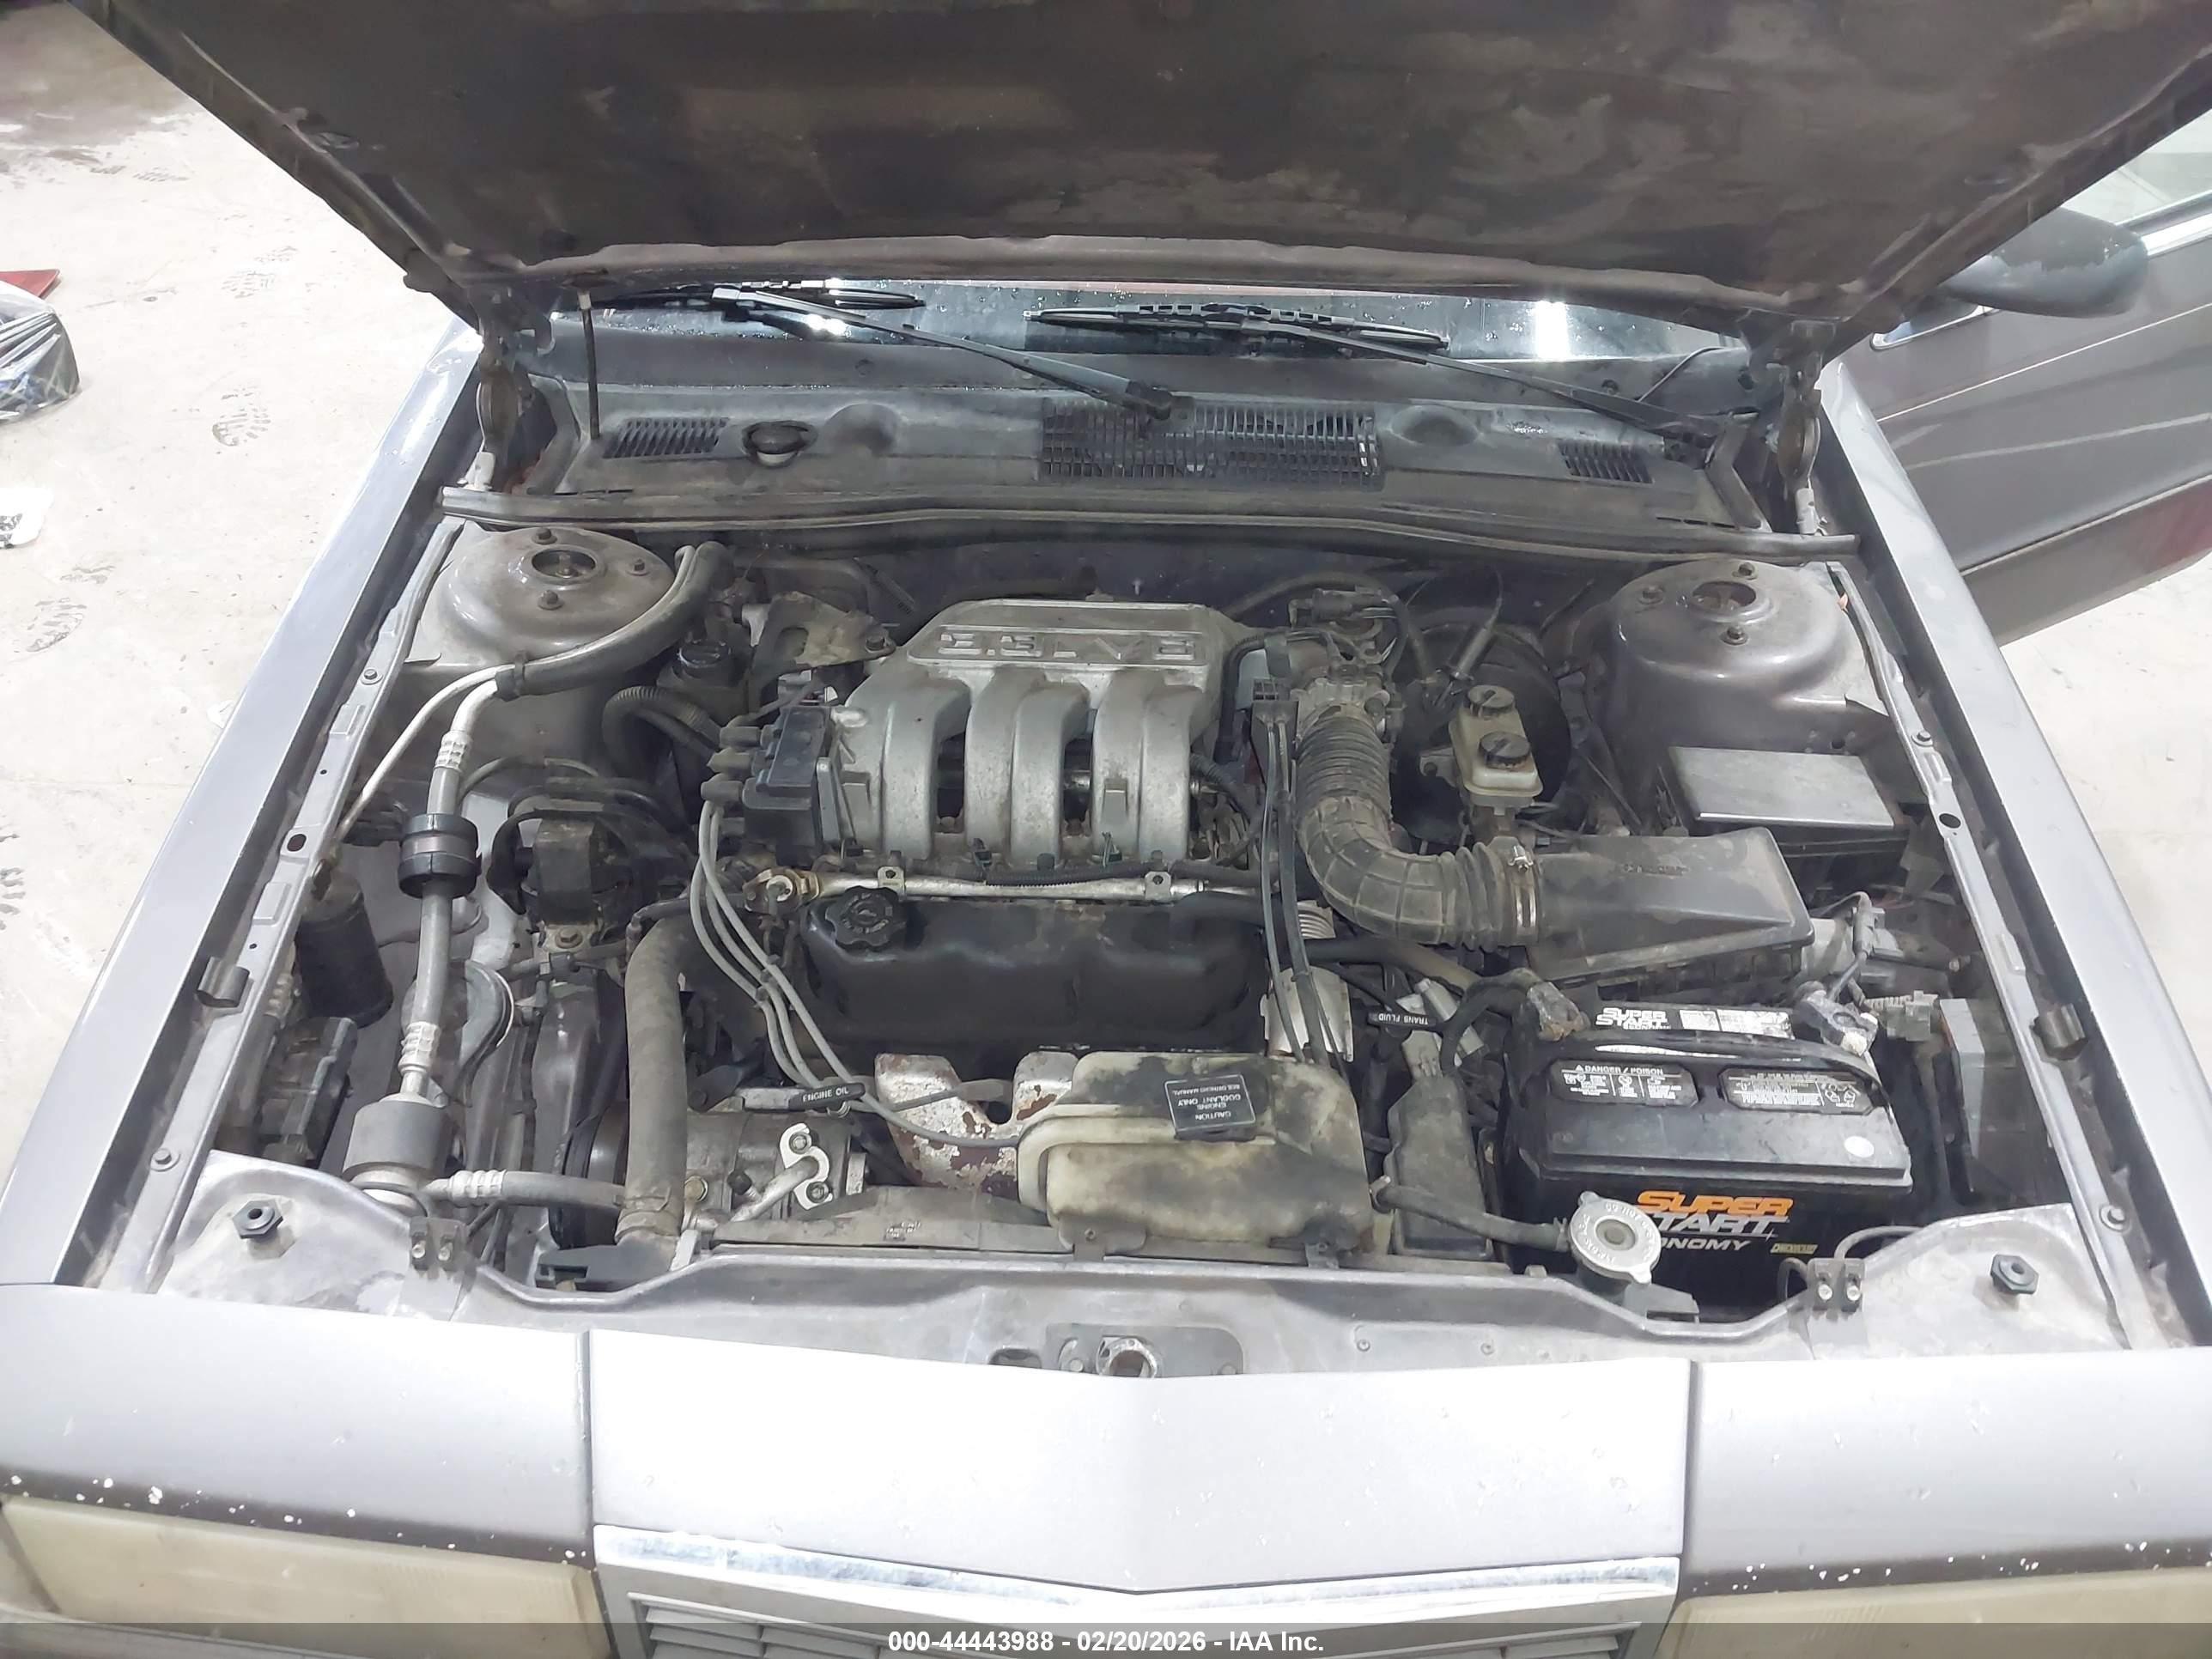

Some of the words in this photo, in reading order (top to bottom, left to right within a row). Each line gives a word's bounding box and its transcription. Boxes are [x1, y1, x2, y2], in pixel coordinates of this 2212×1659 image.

[1378, 1013, 1401, 1023] FLUID
[1603, 1007, 1667, 1020] SUPER
[1403, 1015, 1429, 1025] TRANS
[1595, 1014, 1668, 1026] START
[1584, 1065, 1620, 1073] DANGER
[802, 1089, 833, 1103] ENGINE
[835, 1086, 849, 1097] OIL
[1202, 1094, 1241, 1103] COOLANT
[1177, 1097, 1199, 1107] ONLY
[1196, 1102, 1227, 1110] ENGINE
[1194, 1110, 1231, 1121] CAUTION
[1638, 1190, 1794, 1216] SUPER
[1651, 1212, 1790, 1235] TART
